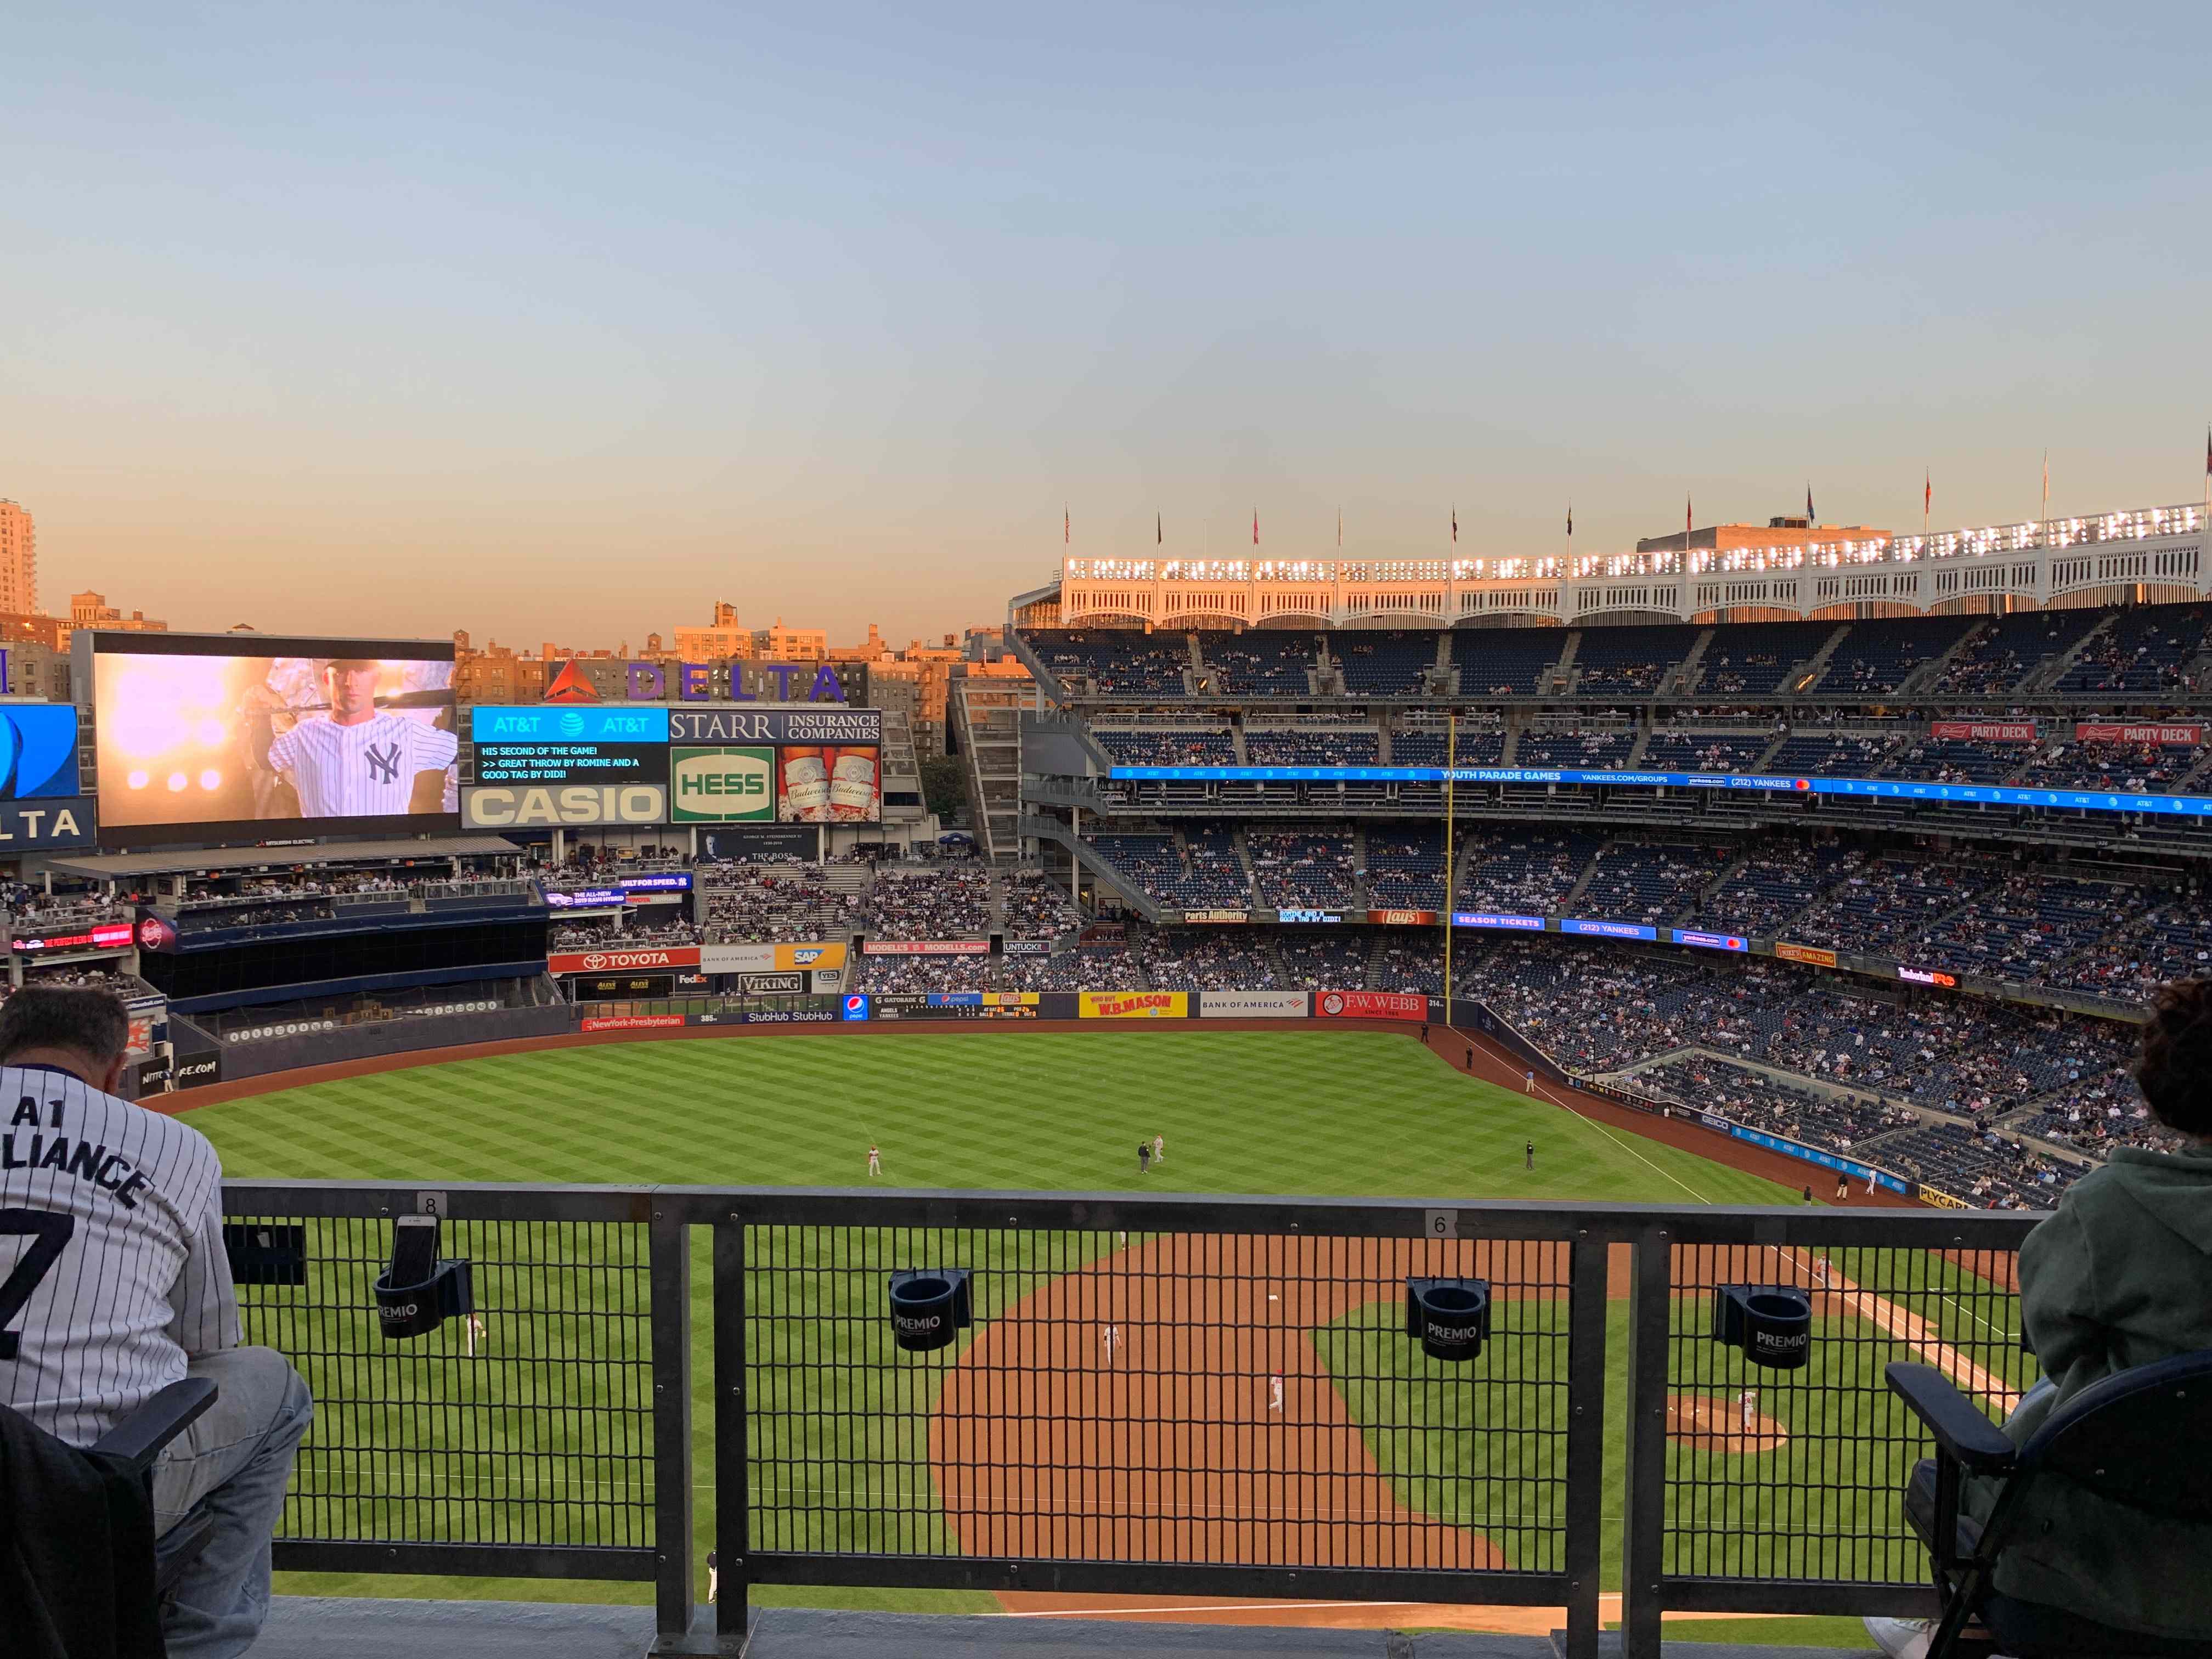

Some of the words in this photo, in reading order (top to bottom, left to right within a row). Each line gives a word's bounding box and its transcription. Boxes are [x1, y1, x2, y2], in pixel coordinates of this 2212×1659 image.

[628, 663, 845, 702] DELTA
[494, 716, 541, 733] AT&T
[603, 717, 650, 733] AT&T
[670, 714, 776, 740] STARR
[788, 715, 879, 727] INSURANCE
[788, 728, 879, 740] COMPANIES
[1972, 726, 2001, 738] PARTY
[2002, 726, 2028, 738] DECK
[2124, 729, 2159, 741] PARTY
[2161, 729, 2193, 741] DECK
[482, 747, 498, 755] HIS
[500, 747, 535, 755] SECOND
[498, 759, 528, 768] GREAT
[564, 759, 575, 767] BY
[577, 759, 611, 767] ROMINE
[633, 759, 640, 767] A
[482, 771, 509, 779] GOOD
[544, 770, 566, 778] DIDI!
[1441, 770, 1477, 779] YOUTH
[1479, 771, 1522, 780] PARADE
[1524, 771, 1561, 781] GAMES
[1582, 774, 1668, 783] YANKEES.COM/GROUPS
[681, 773, 765, 795] HESS
[1731, 778, 1751, 787] (212)
[1753, 779, 1791, 788] YANKEES
[471, 787, 663, 825] CASIO
[772, 852, 794, 860] BOSS
[1208, 911, 1248, 920] Authority
[1458, 916, 1497, 924] SEASON
[1500, 917, 1539, 927] TICKETS
[1579, 923, 1600, 933] (212)
[1602, 925, 1640, 936] YANKEES
[608, 952, 669, 966] TOYOTA
[794, 951, 819, 963] SAP
[1802, 951, 1833, 963] AMAZING
[679, 974, 707, 984] FedEx
[742, 976, 799, 990] VIKING
[1345, 995, 1372, 1008] F.W.
[1376, 996, 1420, 1011] WEBB
[1429, 999, 1439, 1007] 314
[748, 1013, 789, 1022] StubHub
[793, 1012, 833, 1021] StubHub
[592, 1017, 680, 1029] NewYork-Presbyterian
[10, 1096, 64, 1128] A1
[1702, 1114, 1729, 1130] GEICO
[426, 1198, 436, 1215] 8
[1435, 1216, 1446, 1233] 6
[896, 1314, 940, 1330] PREMIO
[1427, 1322, 1477, 1340] PREMIO
[1757, 1330, 1807, 1348] PREMIO
